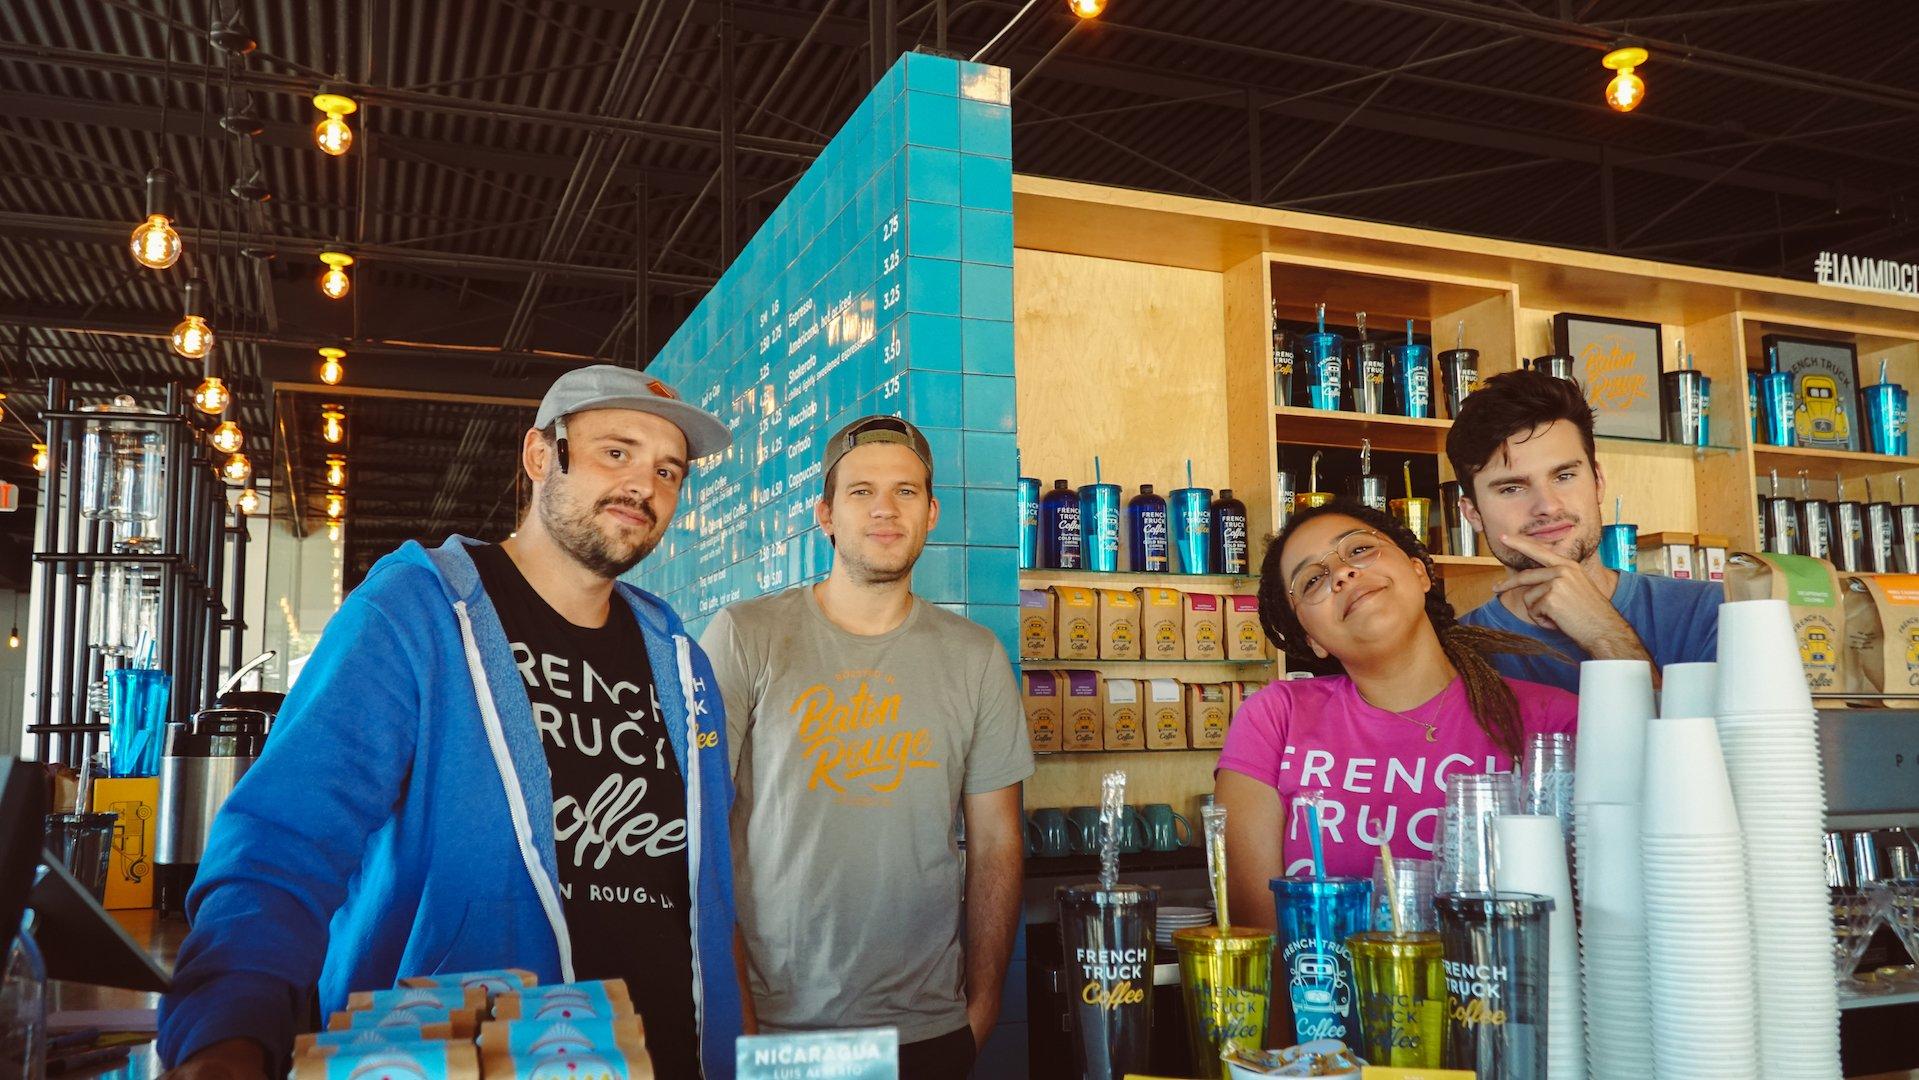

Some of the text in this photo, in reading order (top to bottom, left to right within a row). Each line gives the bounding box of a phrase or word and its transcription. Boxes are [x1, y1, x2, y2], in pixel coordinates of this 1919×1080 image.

[883, 214, 899, 241] 2.75
[883, 249, 900, 275] 3.25
[883, 284, 900, 310] 3.25
[788, 298, 813, 327] Espresso
[884, 339, 901, 364] 3.50
[1274, 351, 1294, 359] RENC
[1580, 342, 1636, 382] Baton
[788, 354, 817, 384] Shakerato
[1274, 364, 1293, 375] Coff
[1791, 357, 1850, 387] ENCH TRUCK
[884, 375, 900, 399] 3.75
[1588, 374, 1648, 410] Rouge
[788, 400, 817, 430] Macchiato
[788, 435, 811, 459] Cortado
[788, 461, 821, 488] Cappuccino
[788, 500, 804, 519] Latte,
[1058, 520, 1081, 531] Coffe
[509, 641, 661, 723] RENC
[789, 682, 902, 743] Baton
[532, 702, 665, 769] RUC
[802, 728, 939, 792] Rouge
[553, 773, 687, 869] offee
[1291, 797, 1440, 852] TRUC
[590, 884, 656, 903] ROUG
[1077, 948, 1147, 963] FRENCH
[1283, 938, 1351, 961] FRENCH TRUC
[1082, 964, 1142, 980] TRUCK
[1441, 959, 1507, 981] RENCH
[1082, 980, 1144, 1010] Coffee
[1193, 985, 1262, 998] RENCH
[1445, 977, 1500, 999] TRUCK
[1202, 1001, 1256, 1014] RUCK
[1449, 996, 1506, 1028] Coffee
[1296, 1016, 1347, 1041] Coffee
[755, 1043, 880, 1066] NICARAGUA
[774, 1065, 862, 1080] LUIS ALBERTO
